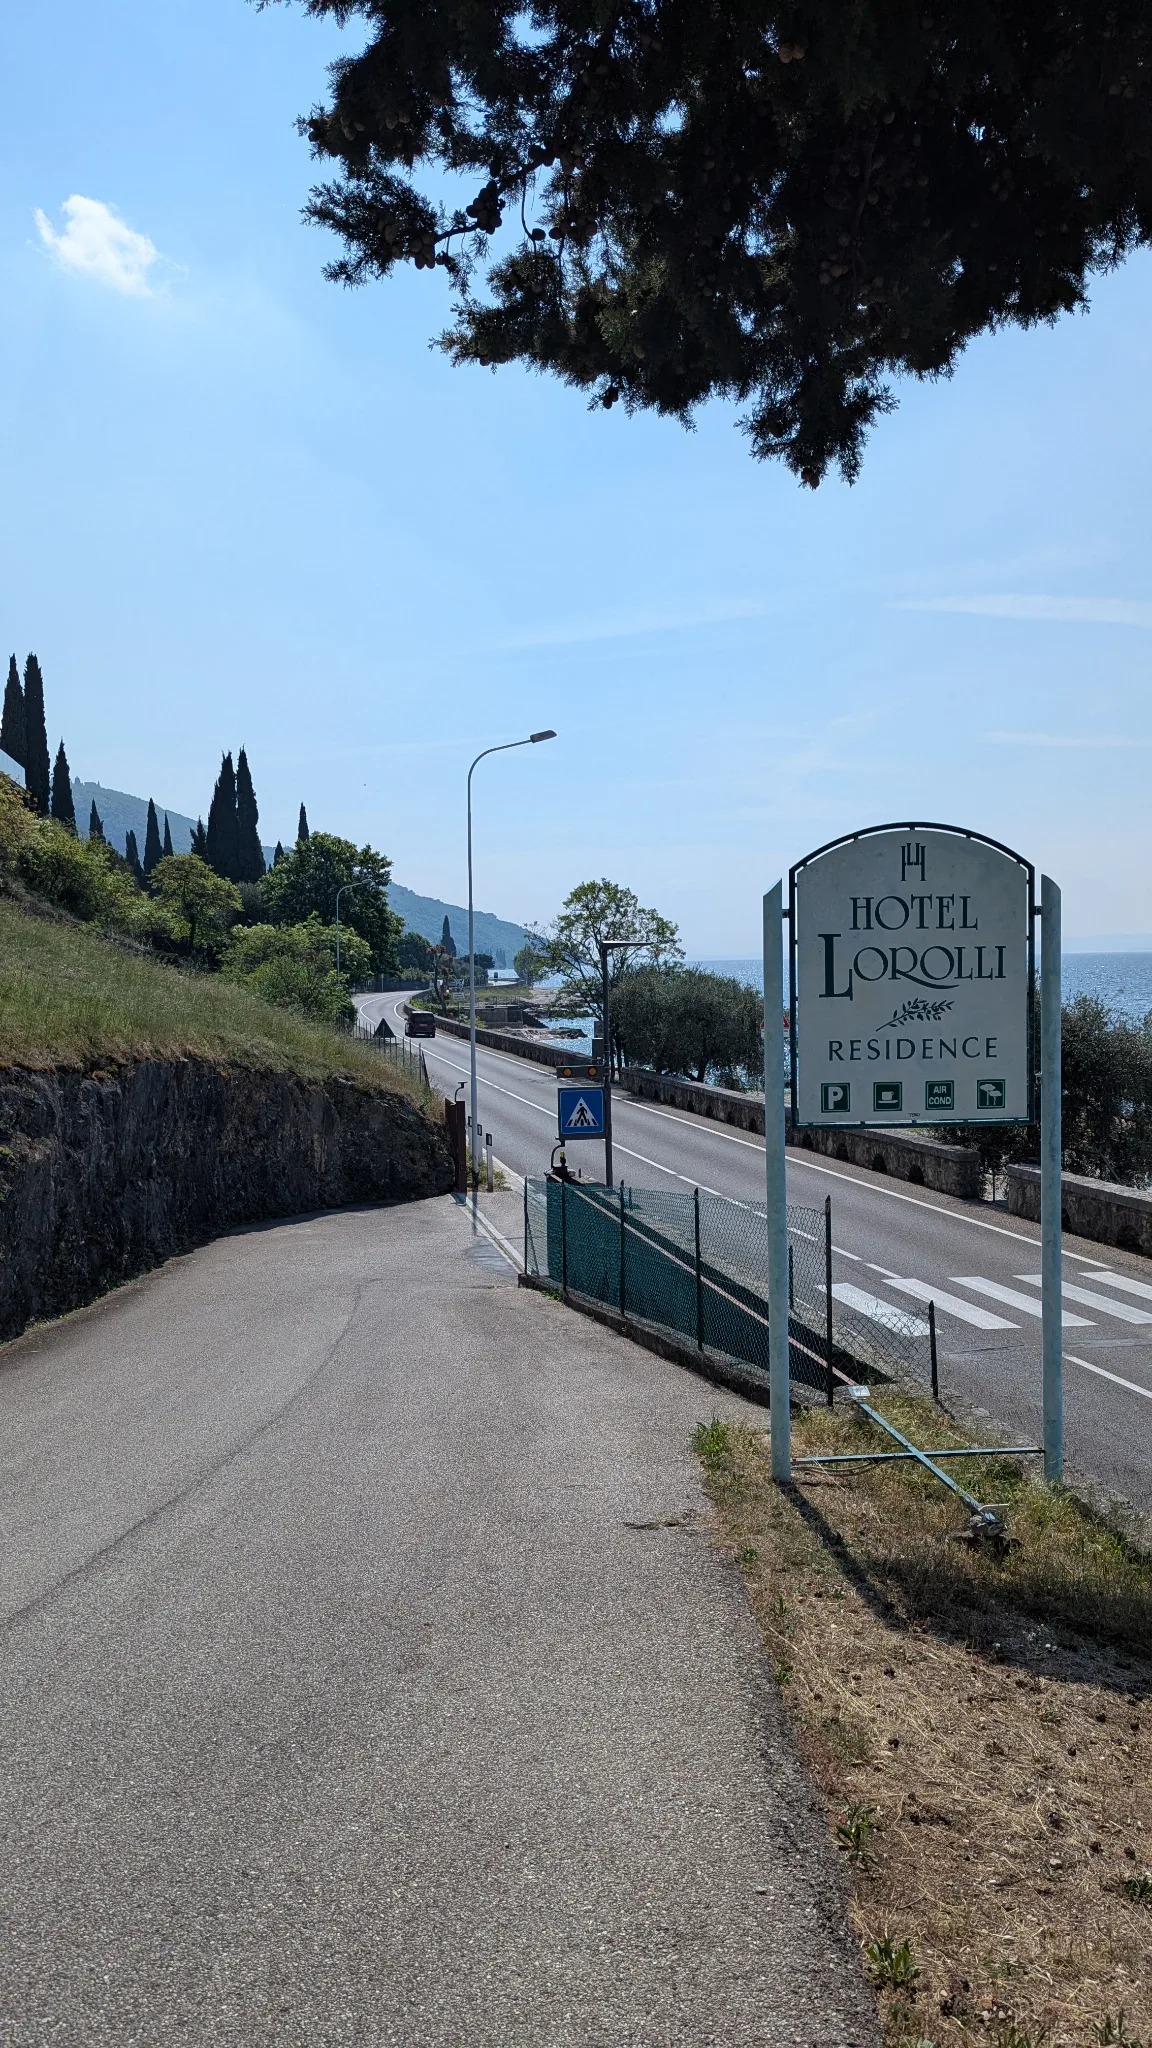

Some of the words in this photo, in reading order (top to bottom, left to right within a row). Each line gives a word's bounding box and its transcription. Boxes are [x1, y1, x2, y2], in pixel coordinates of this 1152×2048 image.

[850, 893, 978, 930] HOTEL
[818, 933, 1007, 1001] LOROLLI
[828, 1037, 998, 1061] RESIDENCE
[828, 1086, 844, 1110] P
[928, 1096, 952, 1106] COND
[933, 1085, 948, 1095] AIR
